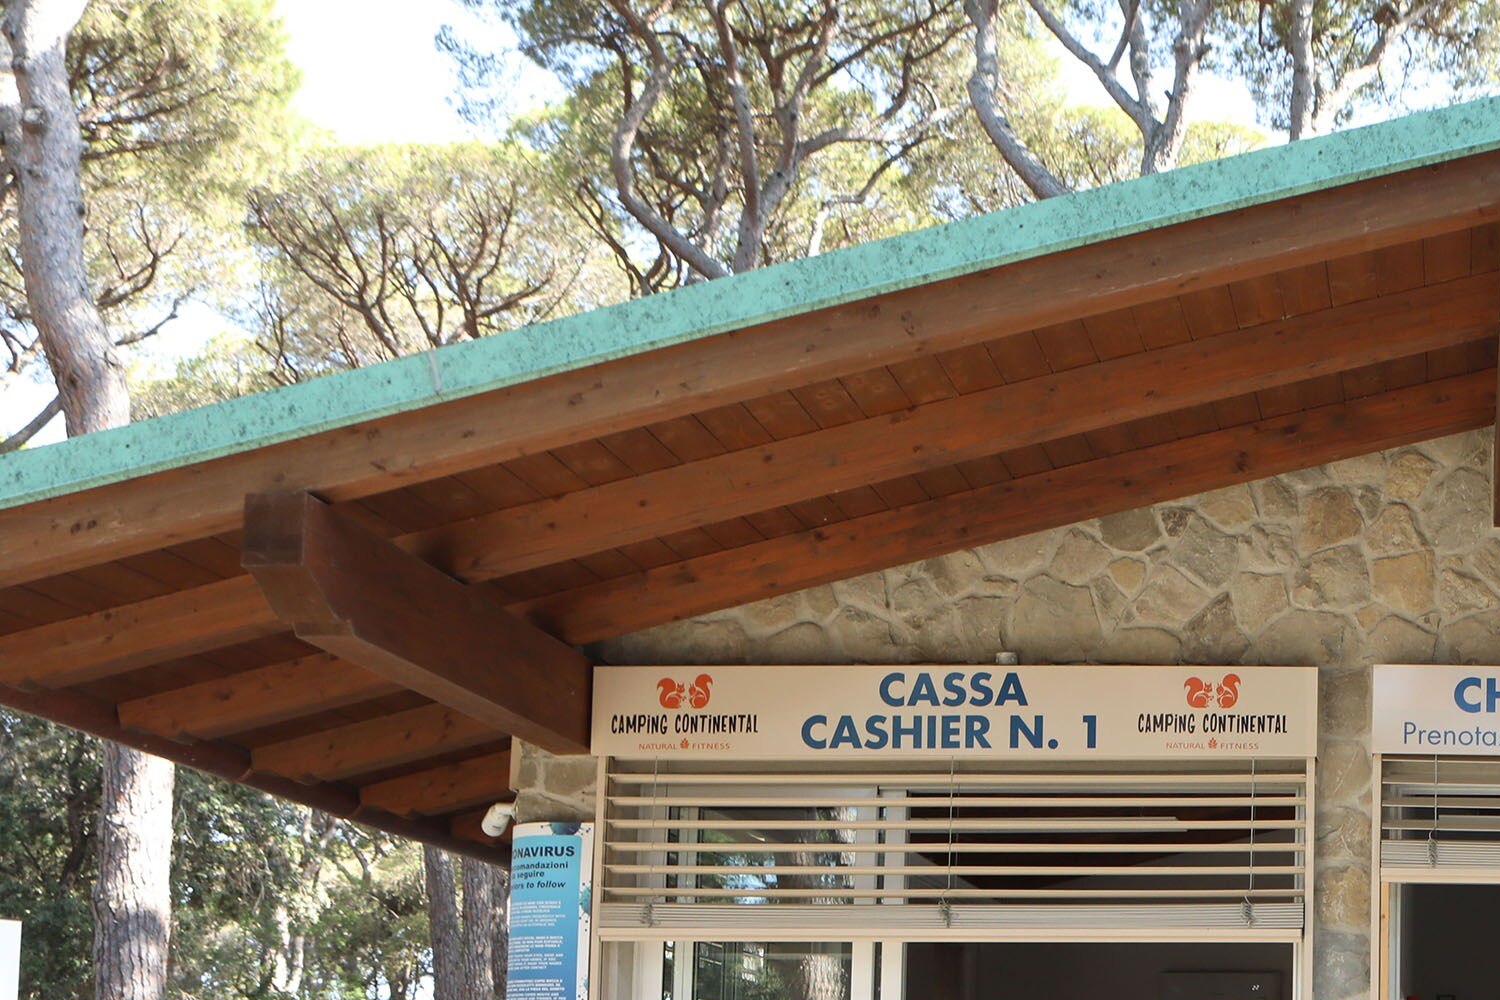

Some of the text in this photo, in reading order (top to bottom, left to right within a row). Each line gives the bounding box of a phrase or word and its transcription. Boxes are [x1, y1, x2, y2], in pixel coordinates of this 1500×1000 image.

[879, 672, 1029, 707] CASSA
[801, 715, 1097, 750] CASHIER N. 1
[1166, 742, 1205, 750] NATURAL
[526, 881, 535, 889] to
[536, 880, 566, 889] follow
